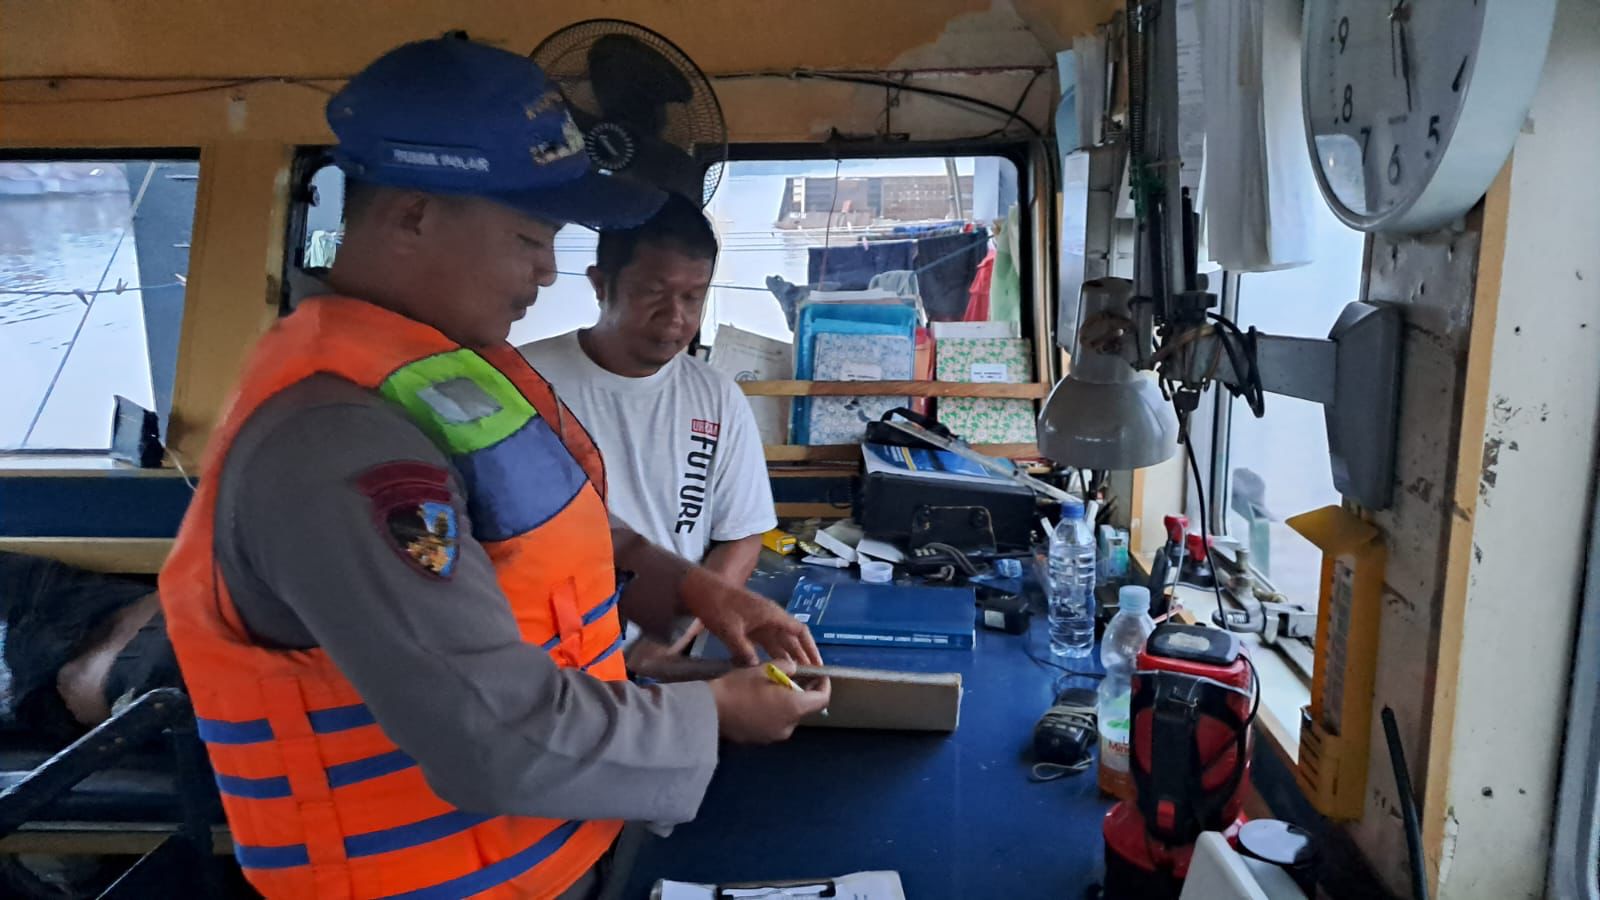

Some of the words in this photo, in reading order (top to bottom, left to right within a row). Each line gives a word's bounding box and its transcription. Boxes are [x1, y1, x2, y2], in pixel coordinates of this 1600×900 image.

[1338, 16, 1350, 54] 9
[1342, 84, 1353, 122] 8
[1360, 126, 1372, 167] 7
[1428, 115, 1441, 145] 5
[1388, 144, 1401, 185] 6
[674, 435, 719, 535] FUTURE
